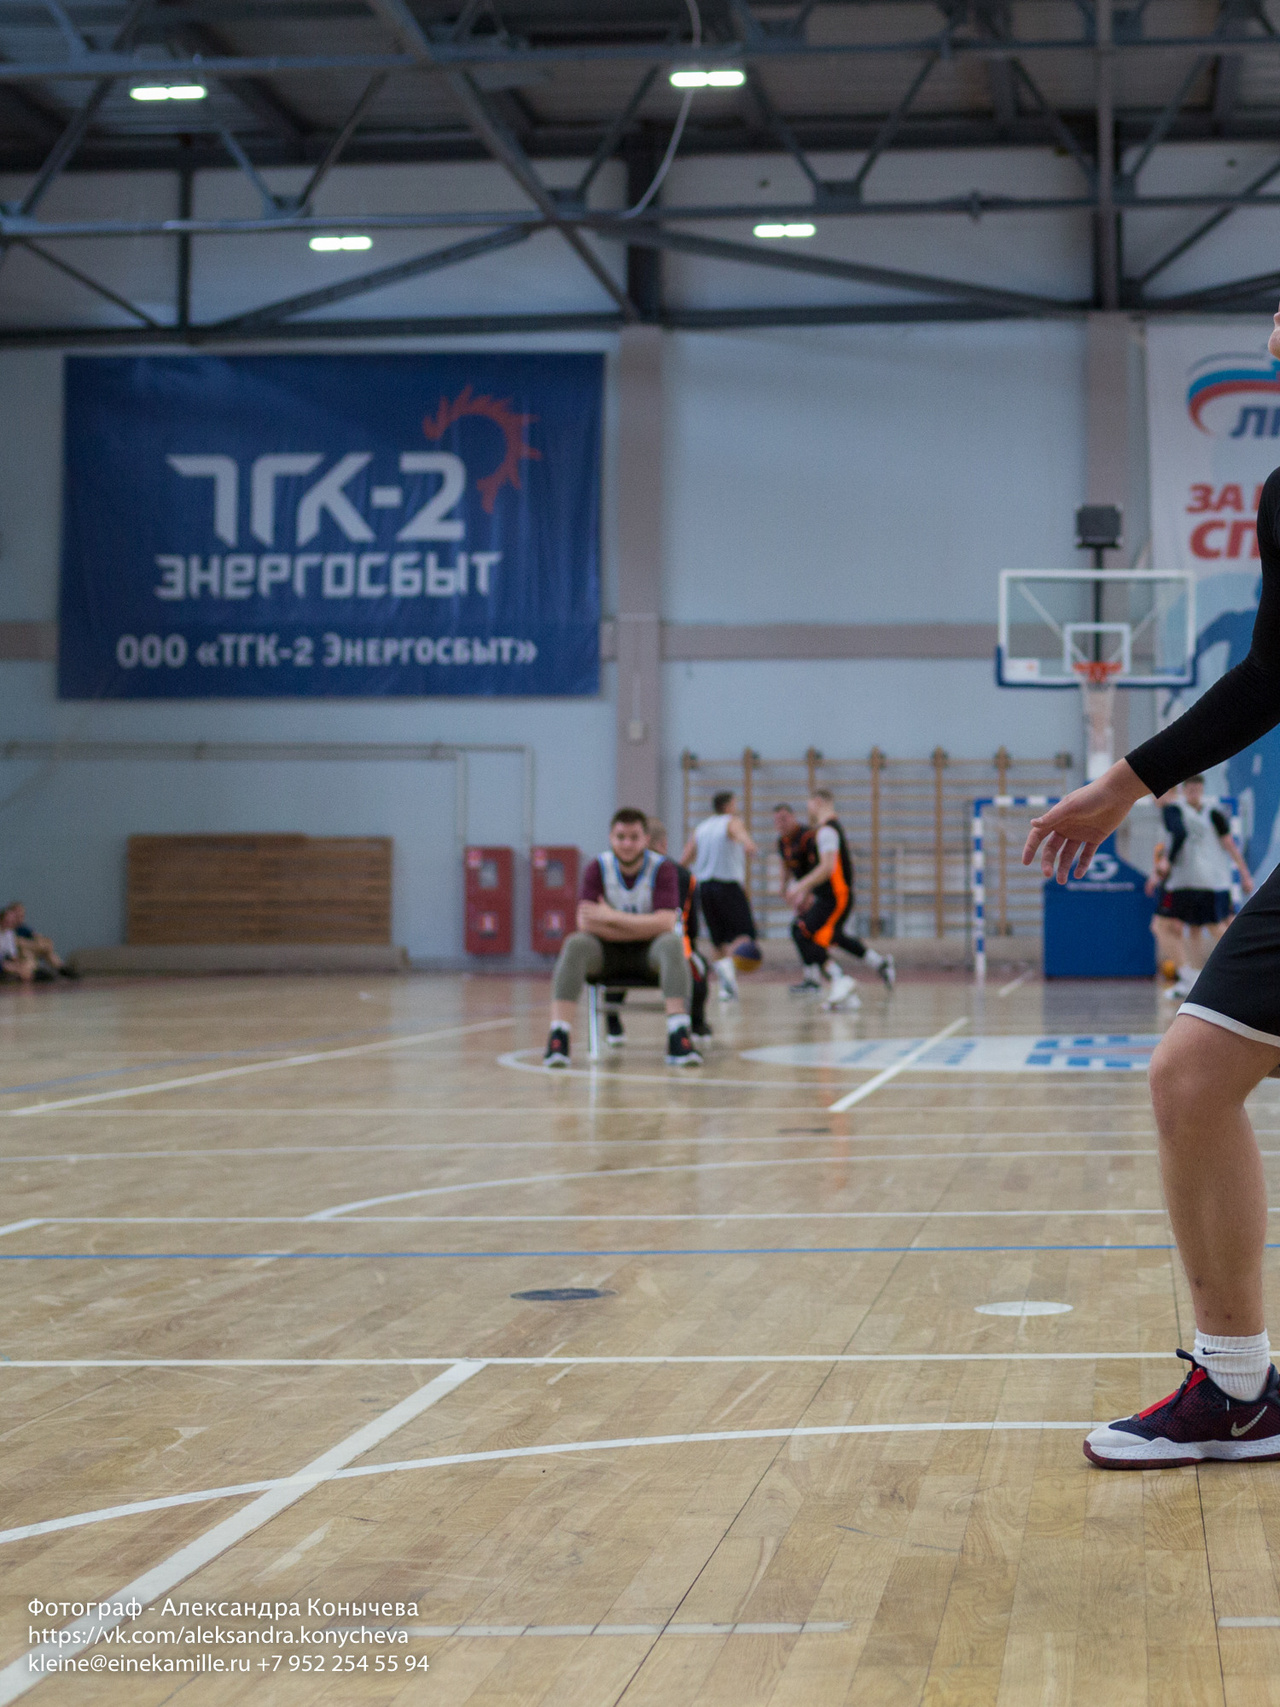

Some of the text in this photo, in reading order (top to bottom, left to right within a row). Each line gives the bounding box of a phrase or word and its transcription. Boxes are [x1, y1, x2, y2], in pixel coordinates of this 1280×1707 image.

[165, 451, 467, 548] ТГК-2
[1186, 483, 1244, 514] ЗА
[154, 551, 503, 601] ЭНЕРГОСБЫТ
[116, 634, 187, 669] ООО
[196, 633, 314, 667] «ТГК-2
